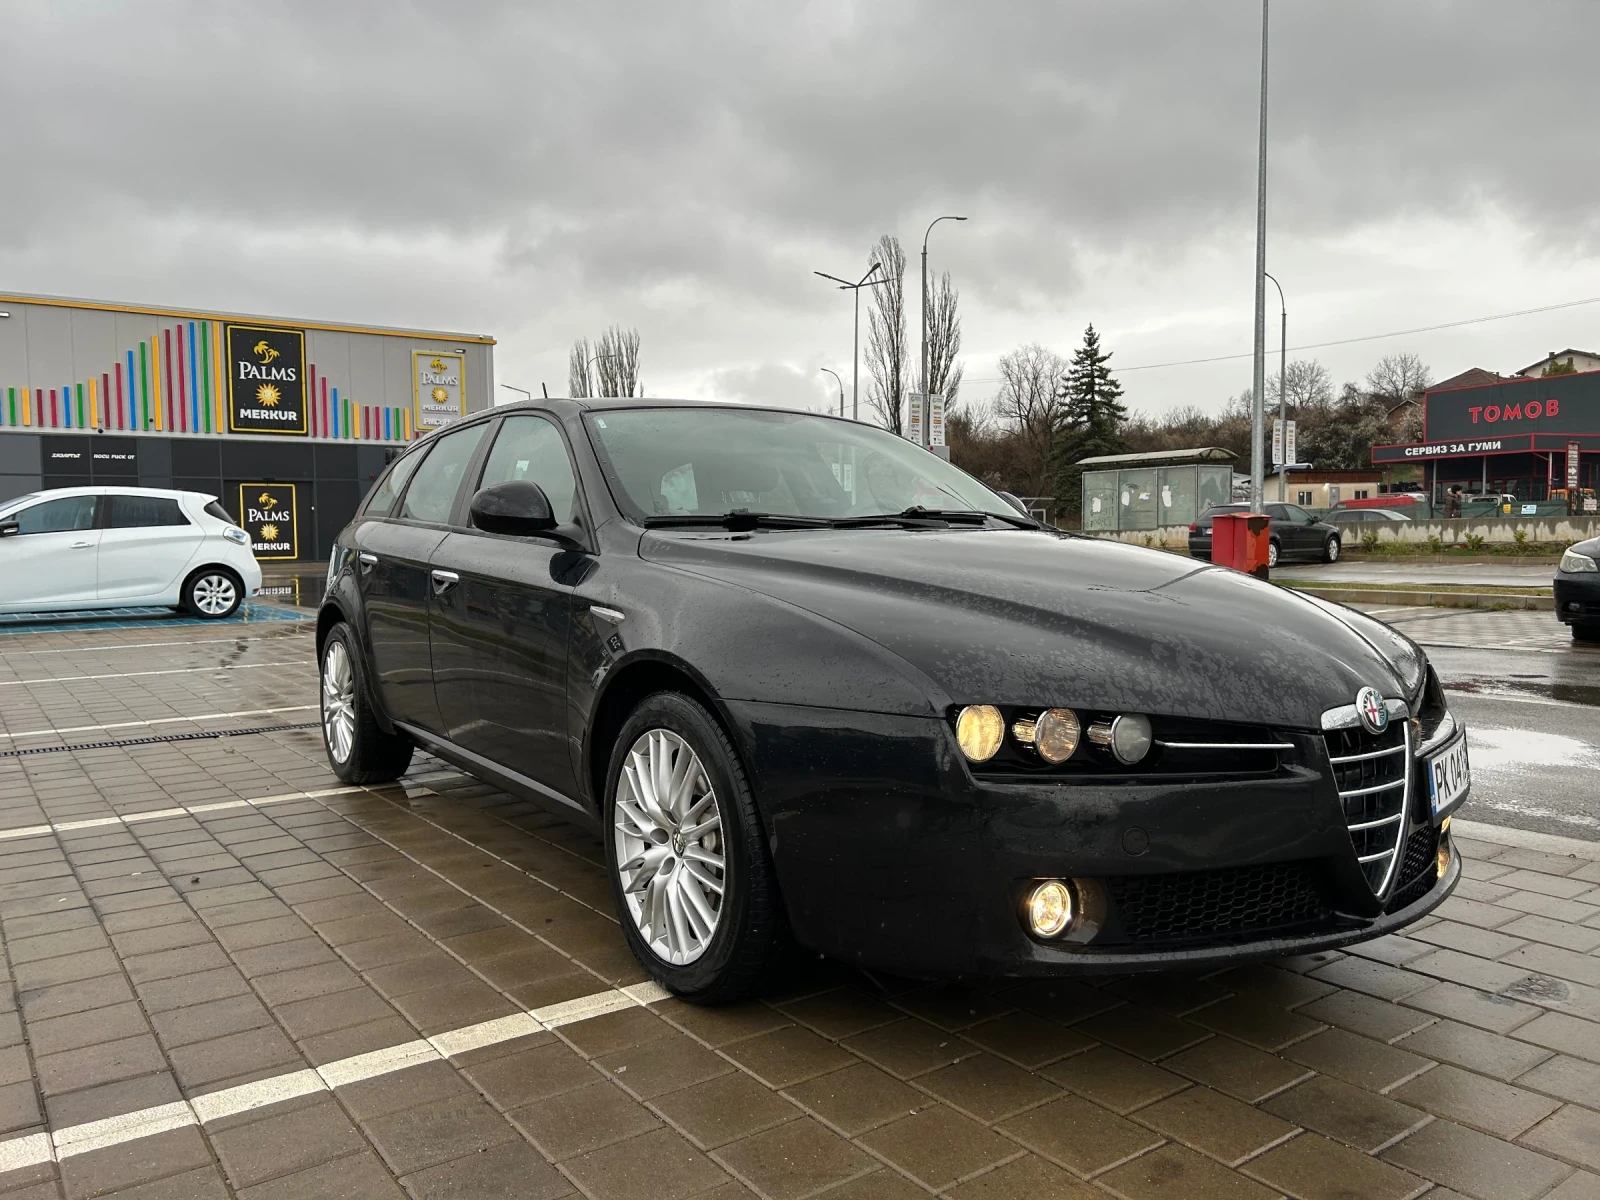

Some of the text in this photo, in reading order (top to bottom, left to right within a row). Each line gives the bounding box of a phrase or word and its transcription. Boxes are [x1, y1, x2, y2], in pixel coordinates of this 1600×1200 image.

[238, 361, 297, 382] PALMS
[421, 372, 458, 385] PALMS
[239, 408, 298, 421] MERKUR
[423, 404, 459, 412] MERKUR
[1469, 399, 1559, 424] ТОМОВ
[1405, 441, 1501, 456] СЕРВИЗ ЗА ГУМИ
[247, 508, 290, 522] PALMS
[251, 542, 291, 551] MERKUR
